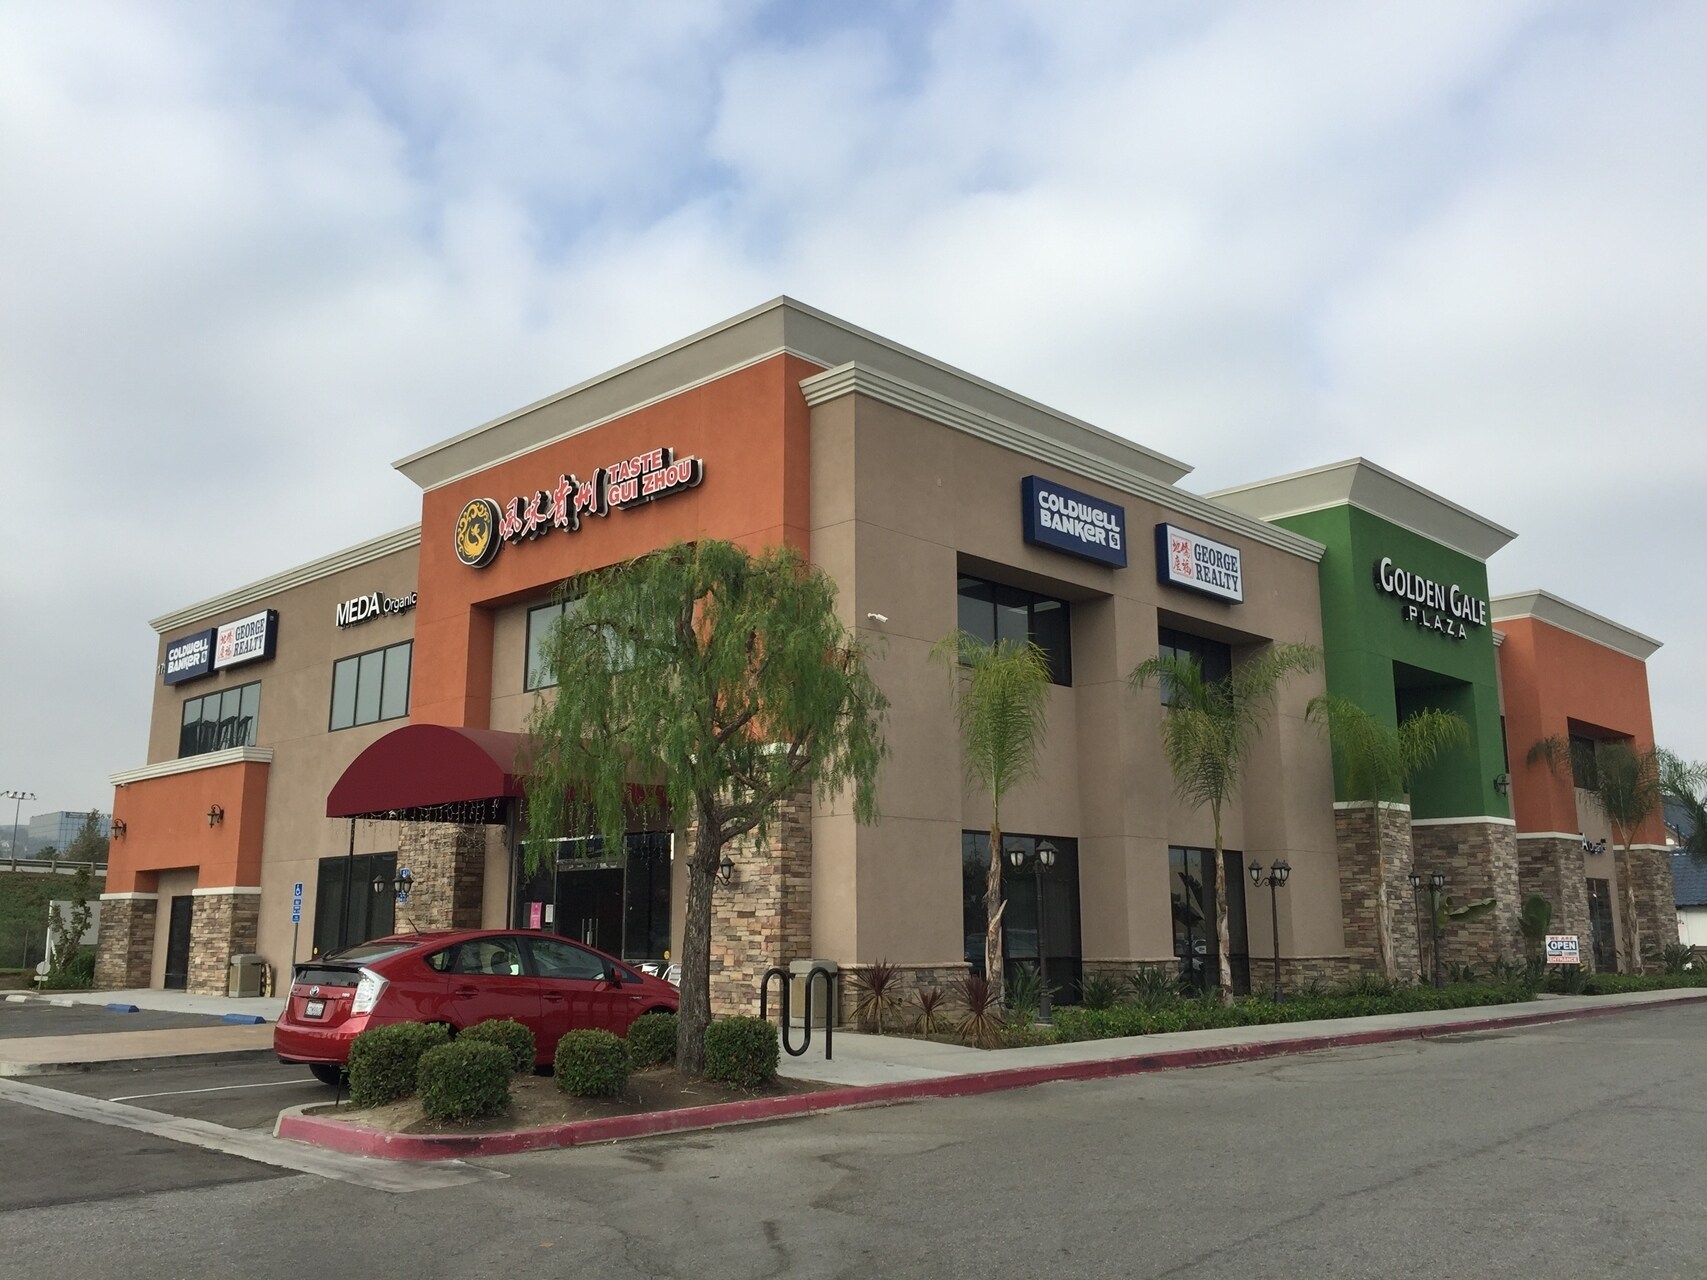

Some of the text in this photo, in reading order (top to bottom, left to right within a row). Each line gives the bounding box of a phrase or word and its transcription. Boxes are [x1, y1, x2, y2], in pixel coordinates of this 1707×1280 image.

[608, 448, 663, 484] TASTE
[607, 460, 691, 506] GUI ZHOU
[1194, 543, 1238, 573] GEORGE
[1195, 563, 1239, 592] REALTY
[1380, 557, 1487, 626] GOLDEN GALE
[336, 592, 380, 626] MEDA
[1409, 605, 1467, 639] PLAZA
[235, 618, 265, 641] GEORGE
[233, 635, 263, 657] REALTY
[1550, 941, 1576, 950] OPEN
